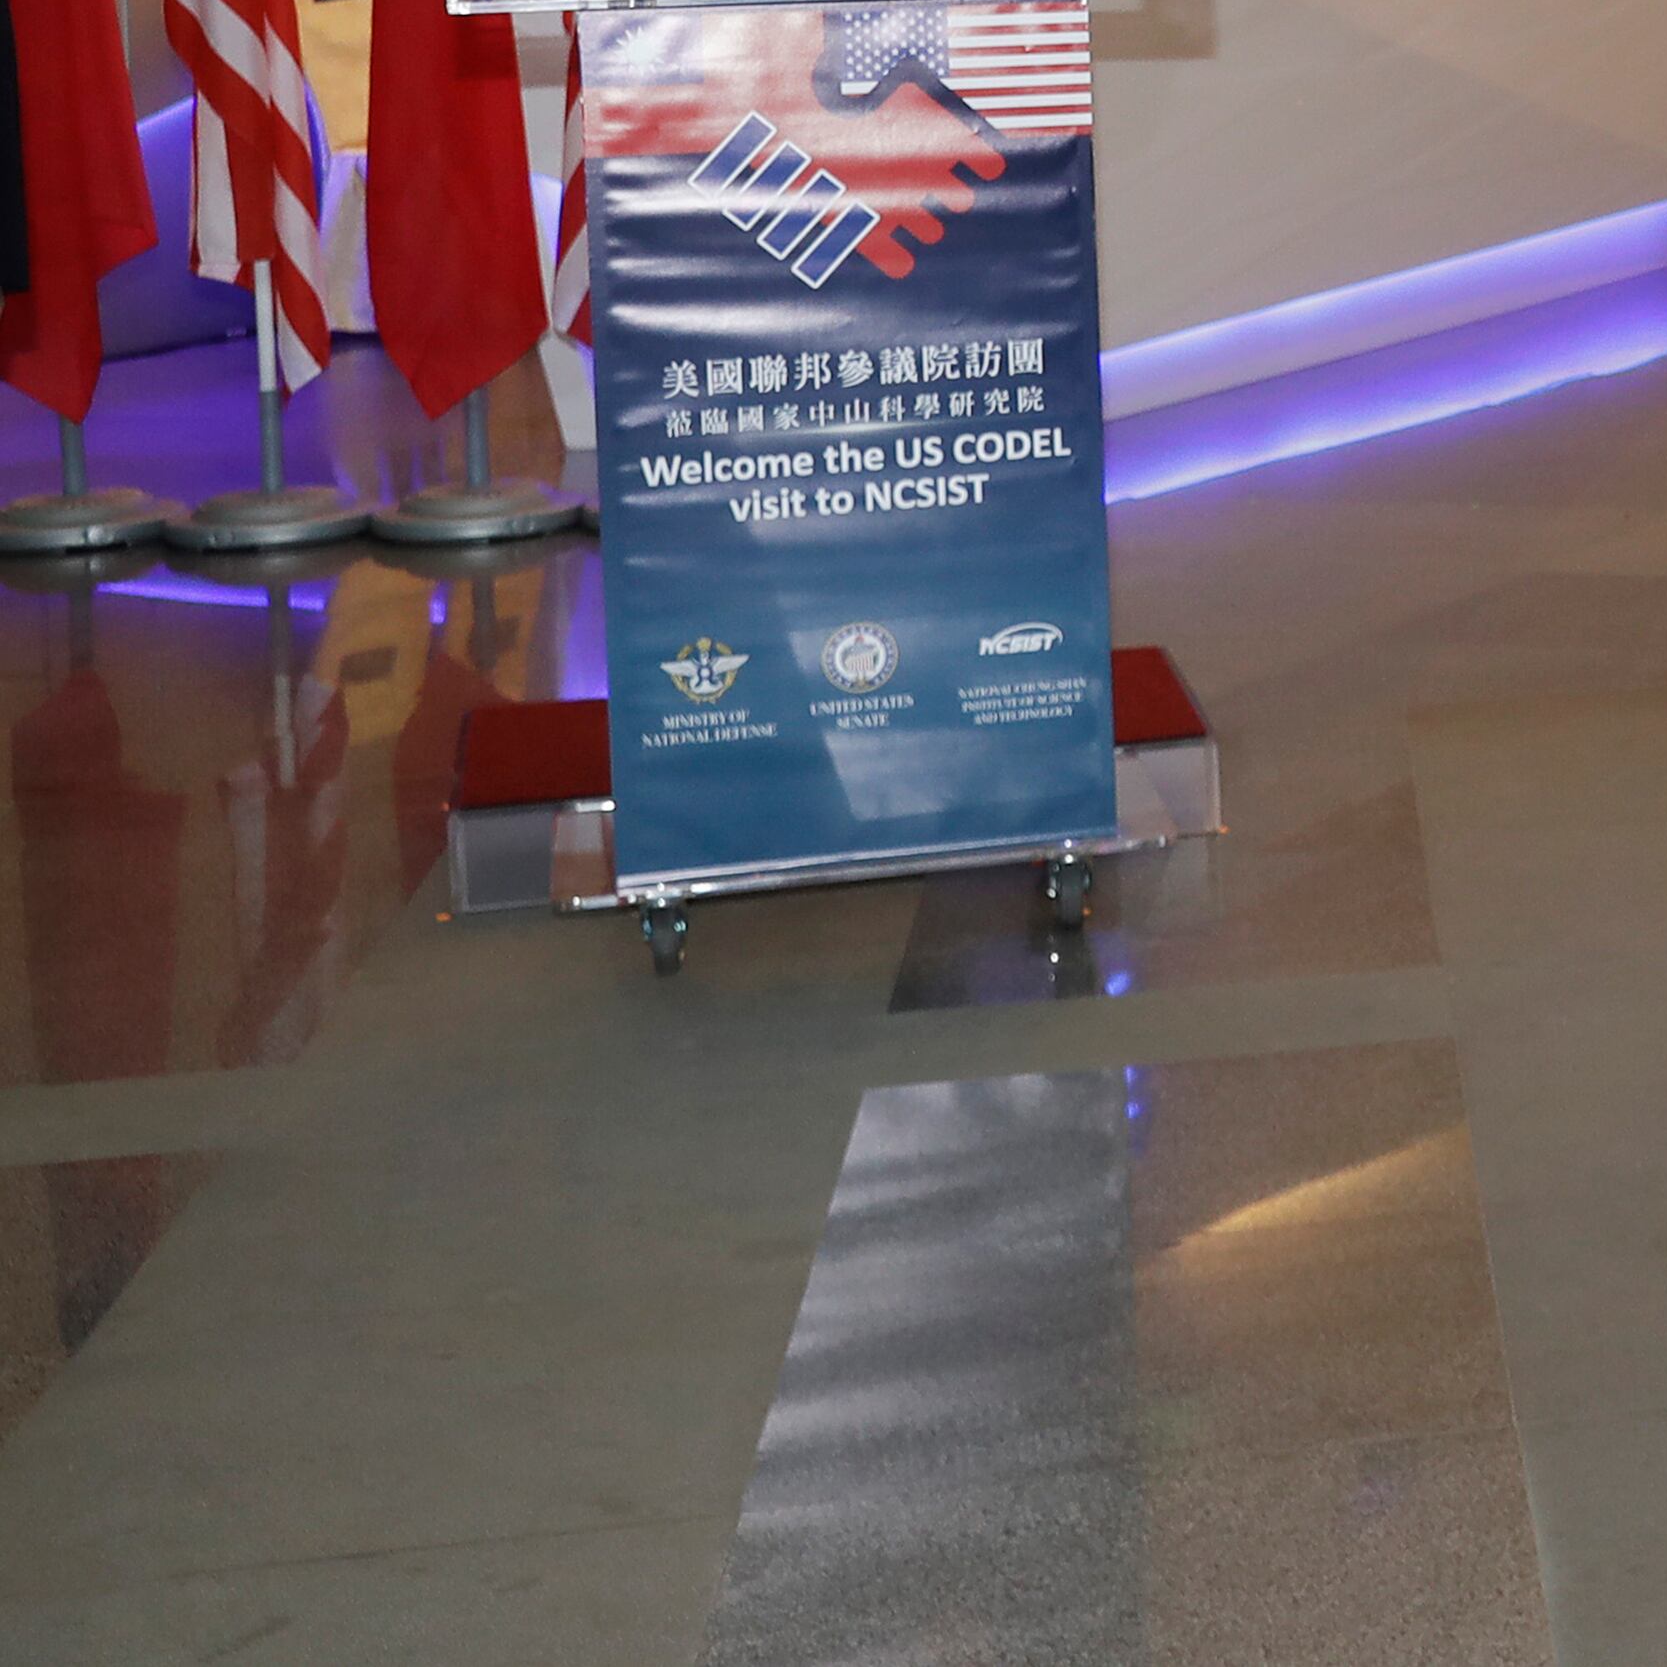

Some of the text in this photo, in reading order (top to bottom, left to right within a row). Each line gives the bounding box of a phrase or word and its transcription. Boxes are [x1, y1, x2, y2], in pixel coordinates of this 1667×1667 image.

[661, 337, 1044, 400] 美國聯邦參議院訪團
[666, 386, 1045, 438] 蒞臨國家中山科學研究院
[641, 428, 1071, 488] Welcome the US CODEL
[730, 473, 990, 522] visit to NCSIST
[979, 632, 1057, 656] NCSIST
